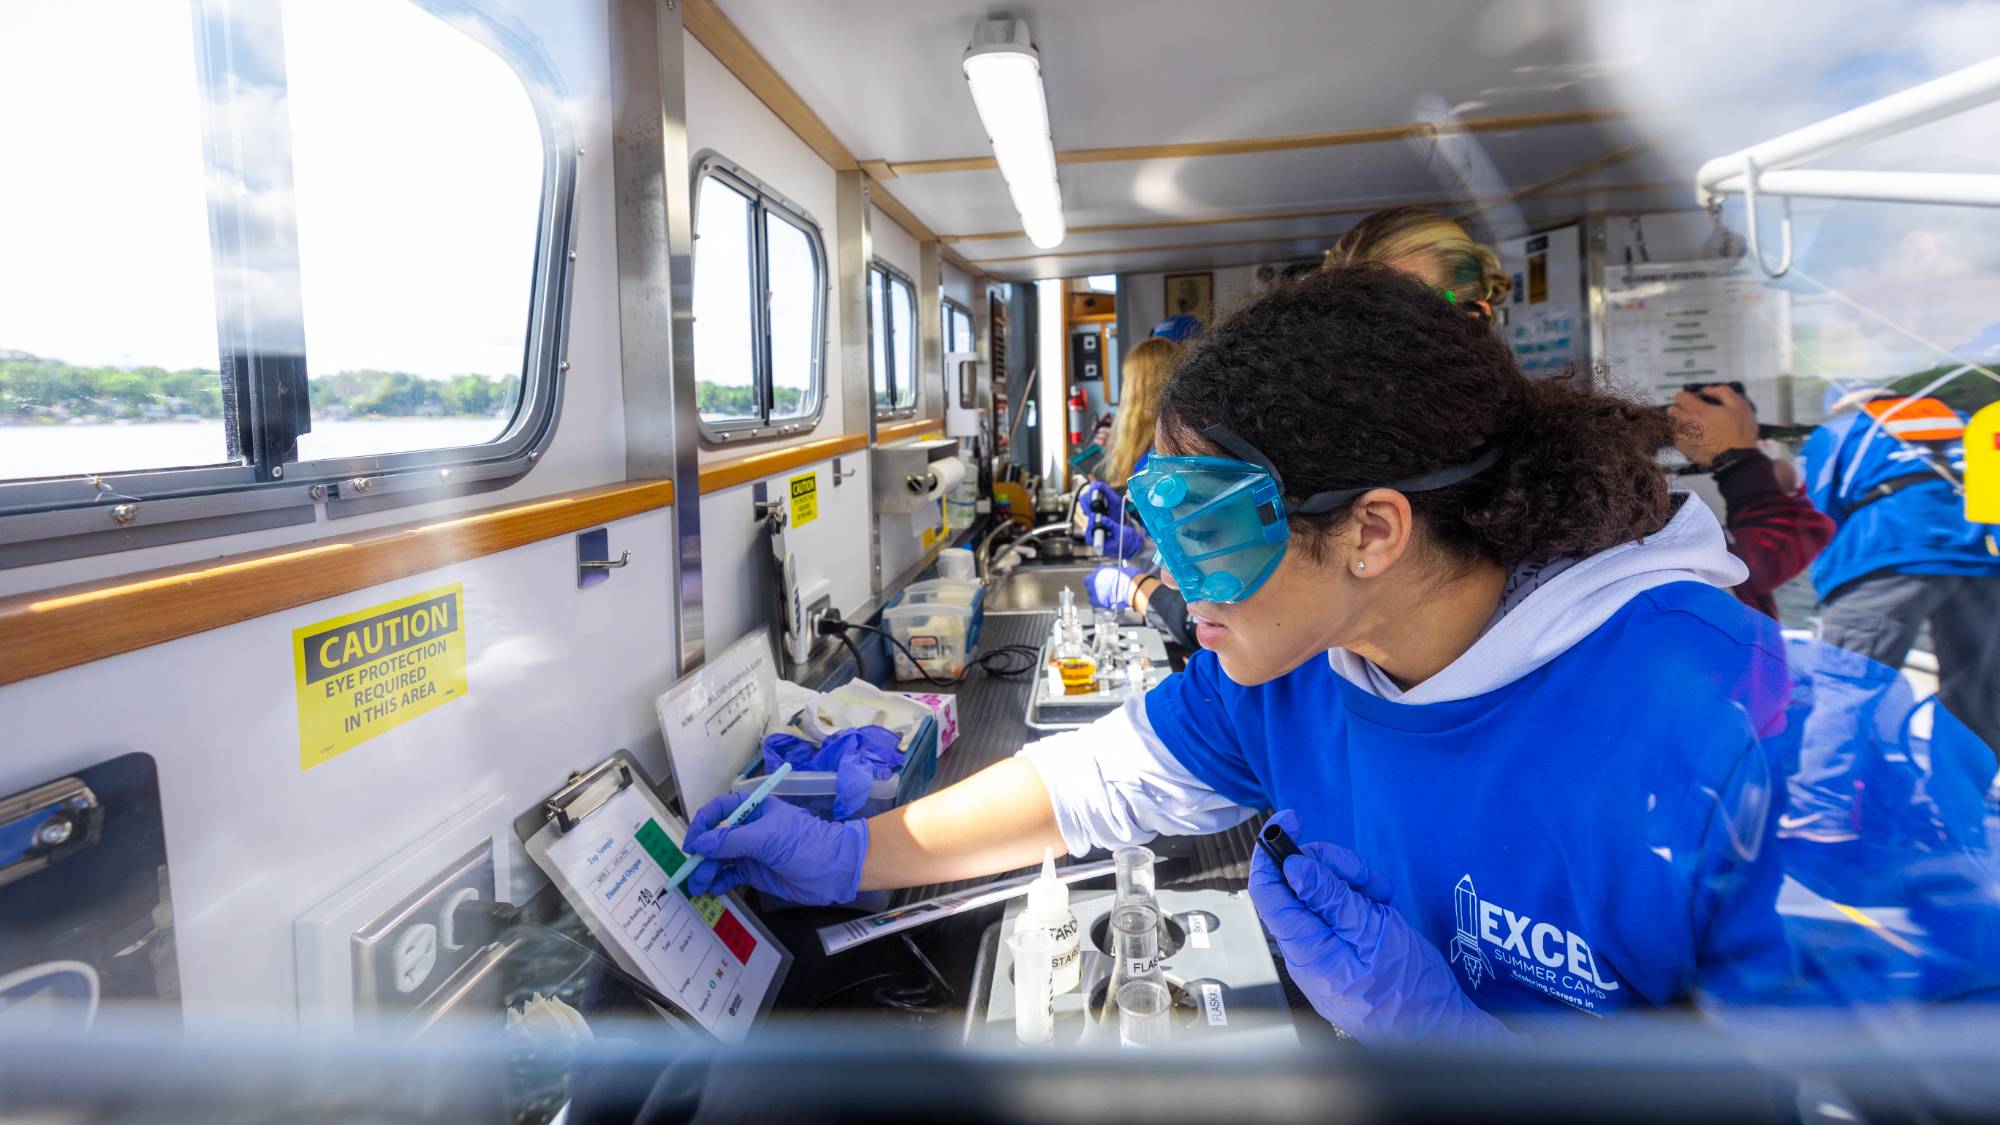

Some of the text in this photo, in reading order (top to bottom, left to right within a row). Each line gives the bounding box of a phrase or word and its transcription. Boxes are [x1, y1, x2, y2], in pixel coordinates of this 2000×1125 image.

[319, 602, 449, 670] CAUTION
[325, 640, 447, 698] EYE PROTECTION
[354, 666, 427, 708] REQUIRED
[344, 681, 436, 734] IN THIS AREA
[624, 858, 642, 879] Oxygen
[1133, 956, 1158, 974] FLAS
[1480, 899, 1619, 991] EXCEL
[1494, 948, 1557, 984] SUMMER
[1207, 987, 1223, 1022] FLASK#2
[1512, 969, 1549, 993] Exploring
[1549, 986, 1583, 1006] Careers
[1585, 998, 1594, 1009] in
[1562, 975, 1607, 1000] CAMP
